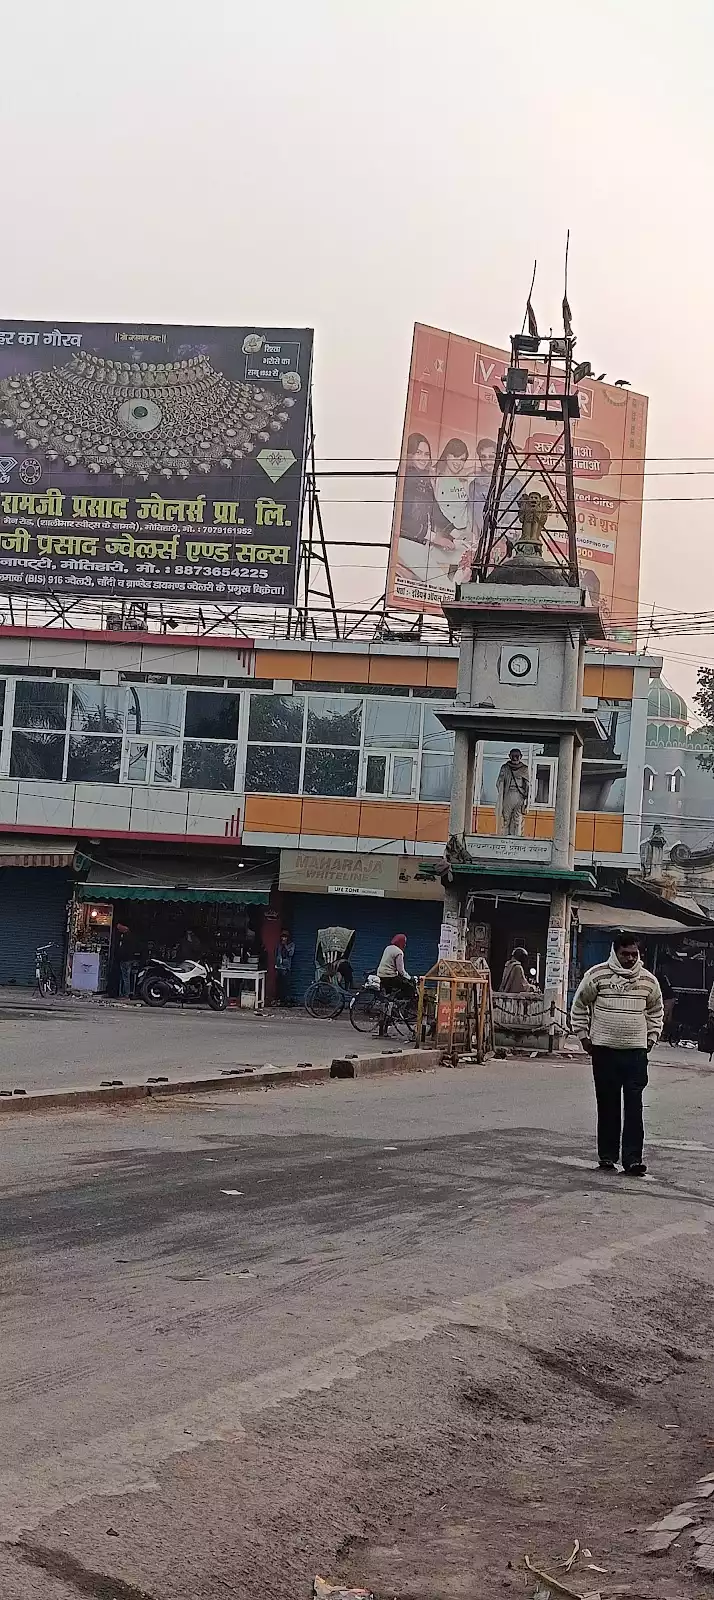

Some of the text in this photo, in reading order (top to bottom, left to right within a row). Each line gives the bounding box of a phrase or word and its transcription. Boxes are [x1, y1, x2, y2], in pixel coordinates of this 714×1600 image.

[18, 332, 40, 346] का
[43, 328, 83, 347] गौरव
[262, 356, 280, 365] भरोसे
[272, 368, 279, 377] से
[1, 487, 292, 527] रामजी प्रसाद ज्वेलर्स प्रा. लि.
[592, 496, 614, 509] Gifts
[3, 516, 18, 525] मेन
[102, 520, 111, 529] के
[144, 523, 180, 533] मोतिहारी,
[202, 526, 253, 535] 7079161952
[588, 513, 598, 527] से
[36, 534, 99, 556] प्रसाद
[104, 532, 180, 561] ज्वेलर्स
[185, 541, 232, 563] एण्ड
[235, 543, 291, 565] सन्स
[60, 558, 130, 574] मोतिहारी,
[136, 562, 160, 574] मो.
[174, 565, 269, 579] 8873654225
[25, 574, 46, 585] (BIS)
[48, 575, 63, 584] 916
[64, 575, 95, 588] ज्वेलरी,
[97, 576, 117, 587] चाँदी
[118, 579, 125, 587] व
[187, 580, 214, 592] ज्वेलरी
[215, 581, 226, 592] के
[227, 584, 252, 595] प्रमुख
[296, 855, 384, 874] MAHARAJA
[306, 869, 369, 881] WHITELINE
